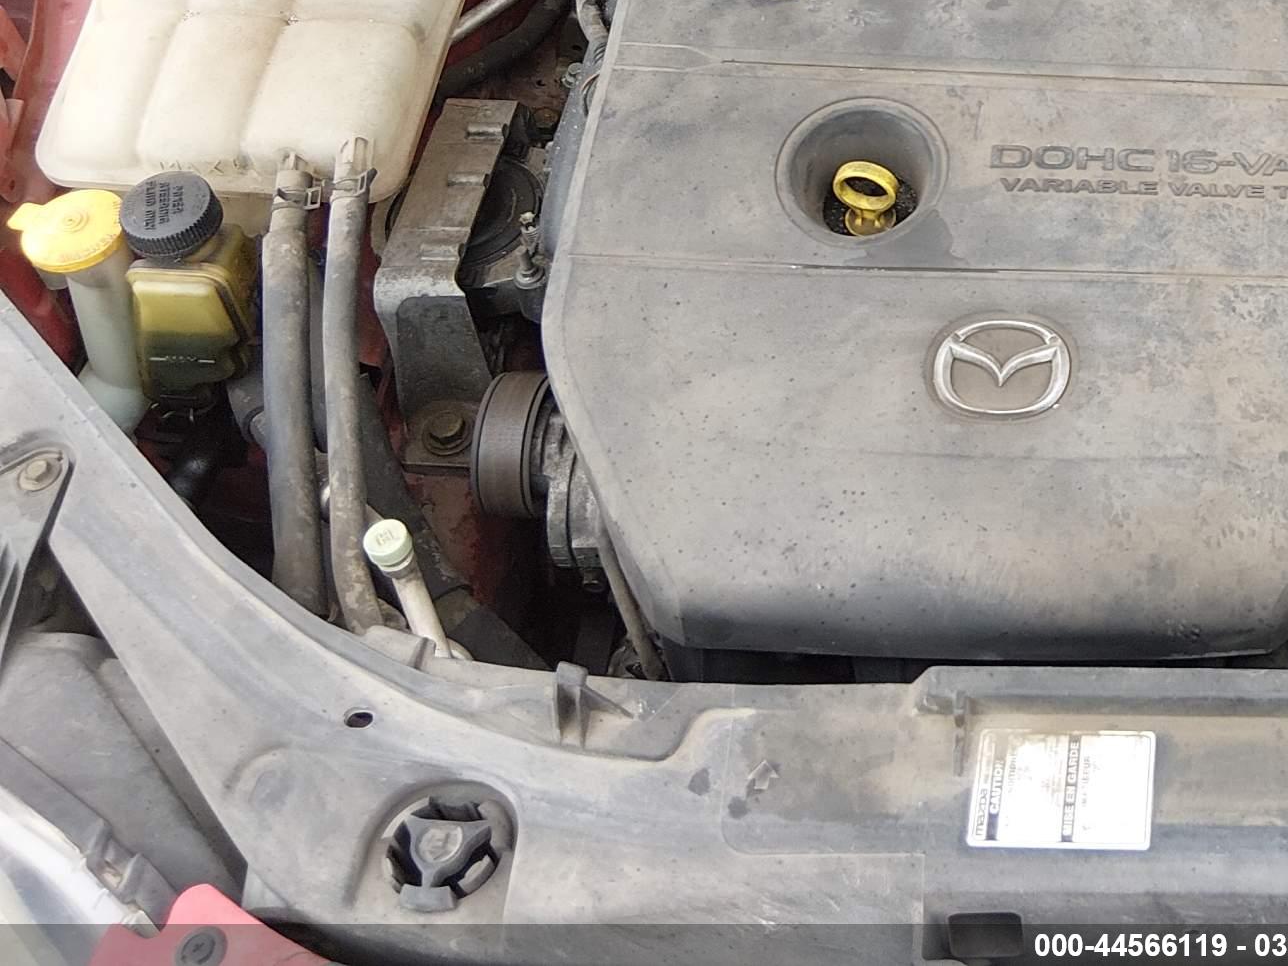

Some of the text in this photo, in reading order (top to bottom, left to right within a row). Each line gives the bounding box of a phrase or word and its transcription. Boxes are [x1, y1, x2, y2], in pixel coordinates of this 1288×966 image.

[989, 144, 1157, 173] DOHC
[999, 177, 1159, 196] VARIABLE
[1167, 181, 1266, 200] VALVE
[989, 759, 1004, 814] CAUTION
[1062, 741, 1080, 836] MISE EN GARDE
[975, 787, 988, 836] mazda
